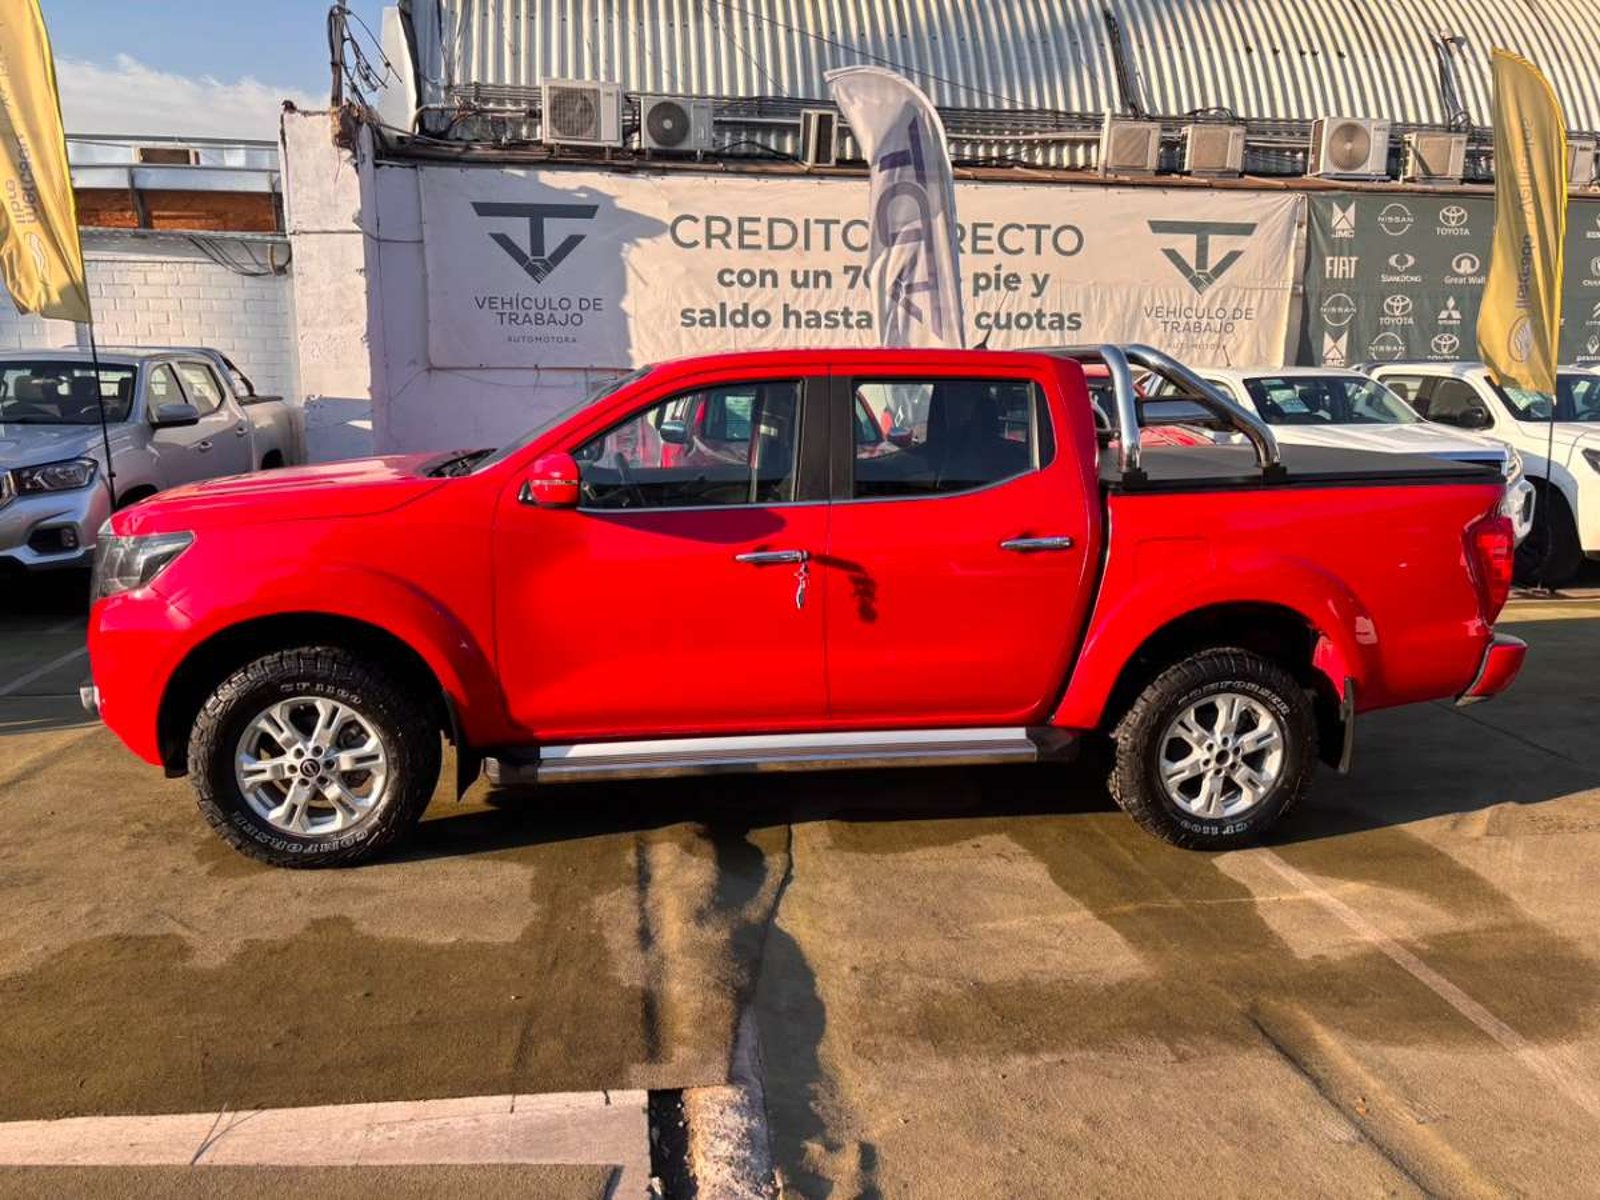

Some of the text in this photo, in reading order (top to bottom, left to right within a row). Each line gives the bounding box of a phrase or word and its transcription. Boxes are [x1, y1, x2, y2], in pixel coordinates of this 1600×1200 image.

[1377, 216, 1414, 224] NISSAN
[670, 214, 869, 252] CREDITO
[1436, 227, 1470, 236] TOYOTA
[1325, 256, 1359, 279] FIAT
[717, 268, 779, 288] con
[790, 269, 832, 289] un
[1030, 272, 1051, 298] y
[1443, 275, 1467, 285] Great
[474, 292, 604, 311] VEHÍCULO DE
[495, 312, 584, 327] TRABAJO
[680, 302, 1083, 331] saldo hasta cuotas
[1232, 308, 1255, 320] DE
[1160, 321, 1235, 334] TRABAJO
[1379, 317, 1414, 325] TOYOTA
[507, 335, 577, 343] AUTOMOTORA
